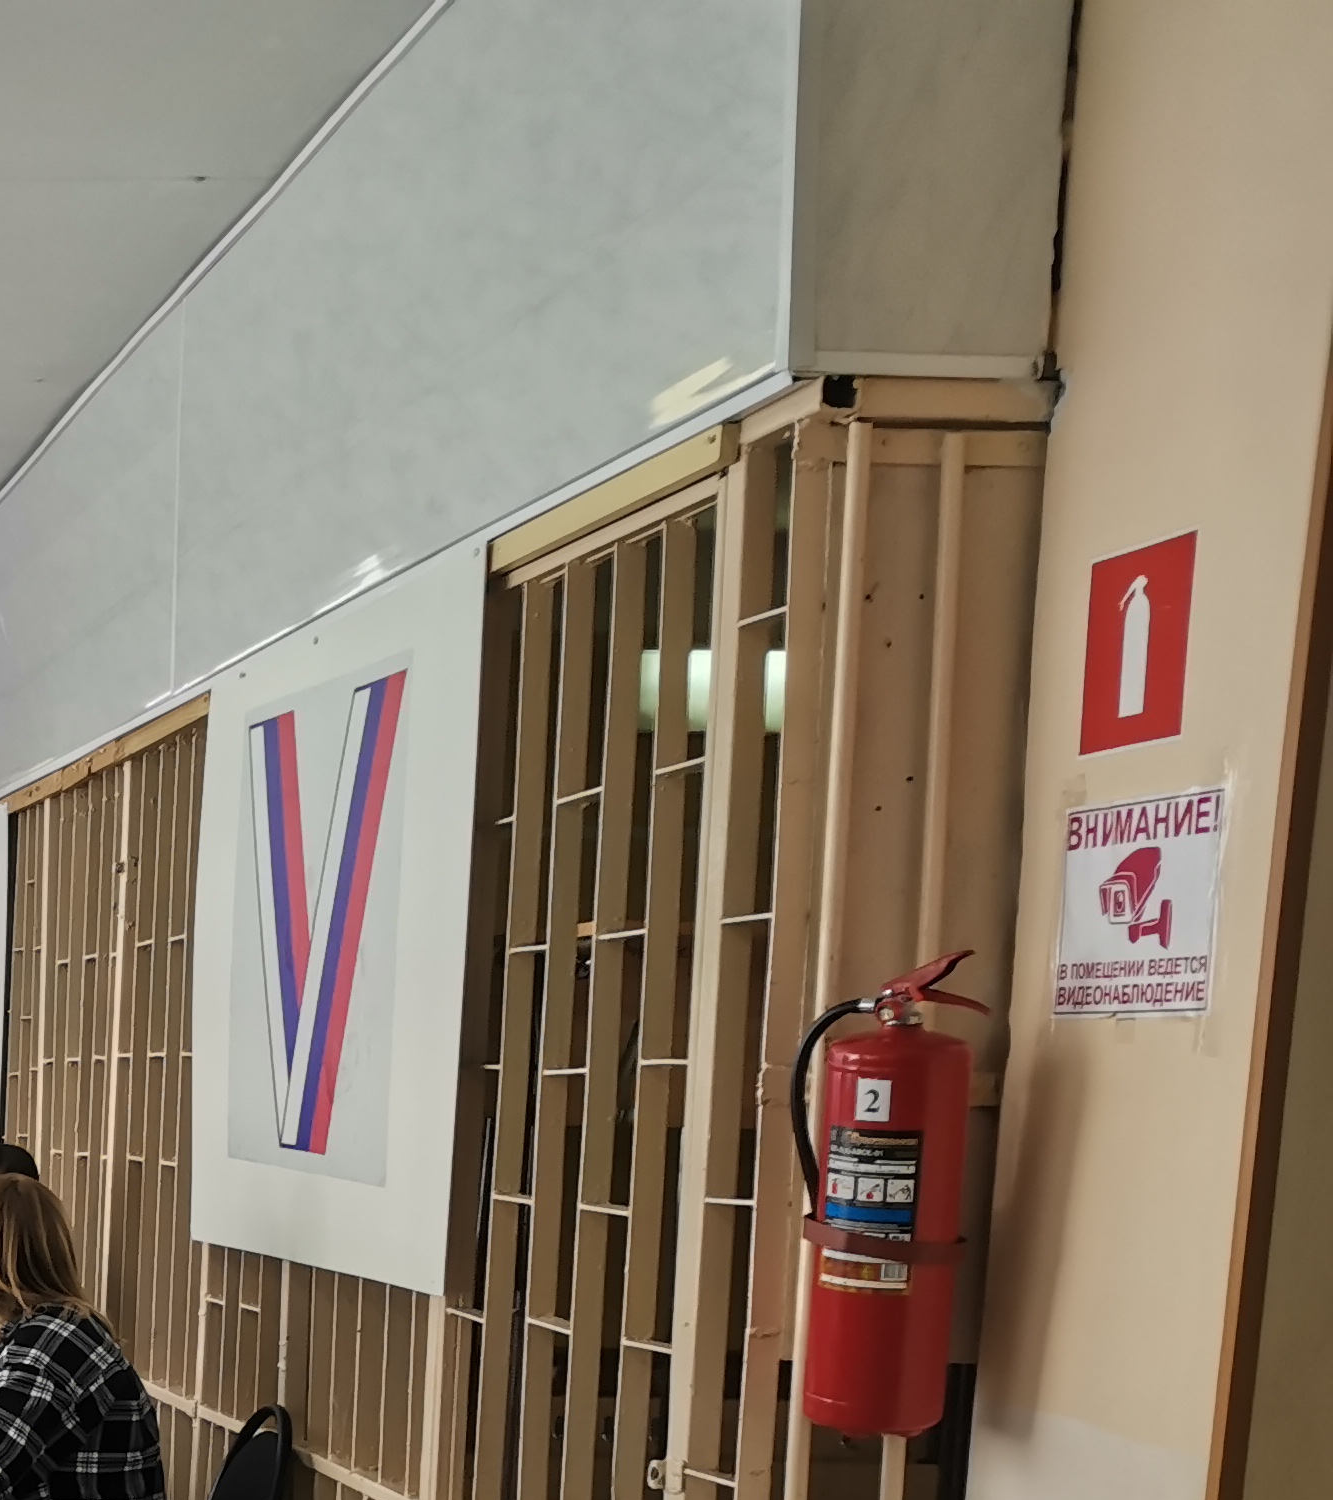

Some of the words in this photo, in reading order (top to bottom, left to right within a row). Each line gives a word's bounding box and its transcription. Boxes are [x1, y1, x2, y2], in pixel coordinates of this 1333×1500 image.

[1067, 794, 1221, 851] ВНИМАНИЕ!
[1059, 963, 1068, 980] В
[1070, 959, 1145, 982] ПОМЕЩЕНИИ
[1148, 955, 1208, 979] ВЕДЕТСЯ
[1057, 980, 1206, 1010] ВИДЕОНАБЛЮДЕНИЕ
[863, 1089, 881, 1113] 2
